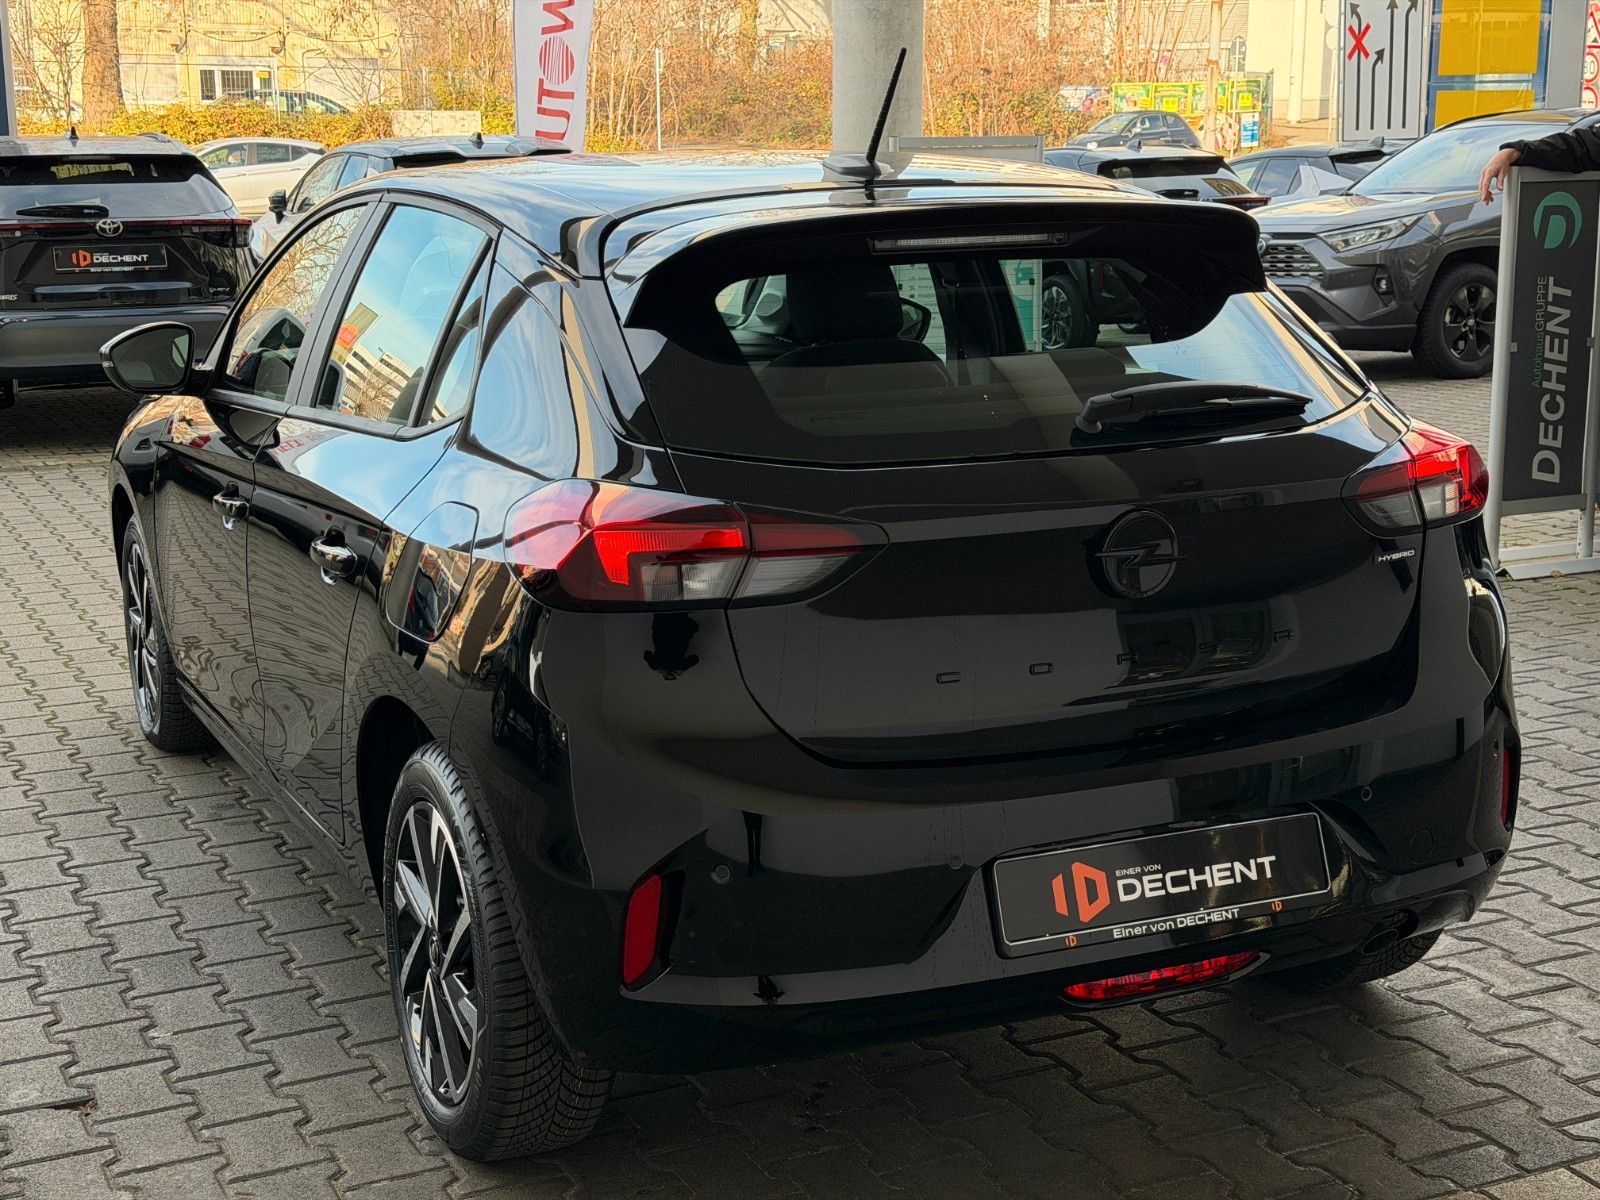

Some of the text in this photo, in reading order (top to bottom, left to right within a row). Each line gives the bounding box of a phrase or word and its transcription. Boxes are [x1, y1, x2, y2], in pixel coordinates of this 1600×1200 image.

[93, 254, 149, 263] DECHENT
[1531, 276, 1572, 484] DECHENT
[1378, 549, 1415, 563] HYBRID
[1115, 863, 1162, 877] EINER VON
[1116, 855, 1277, 903] DECHENT
[1112, 908, 1240, 940] Einer von DECHENT
